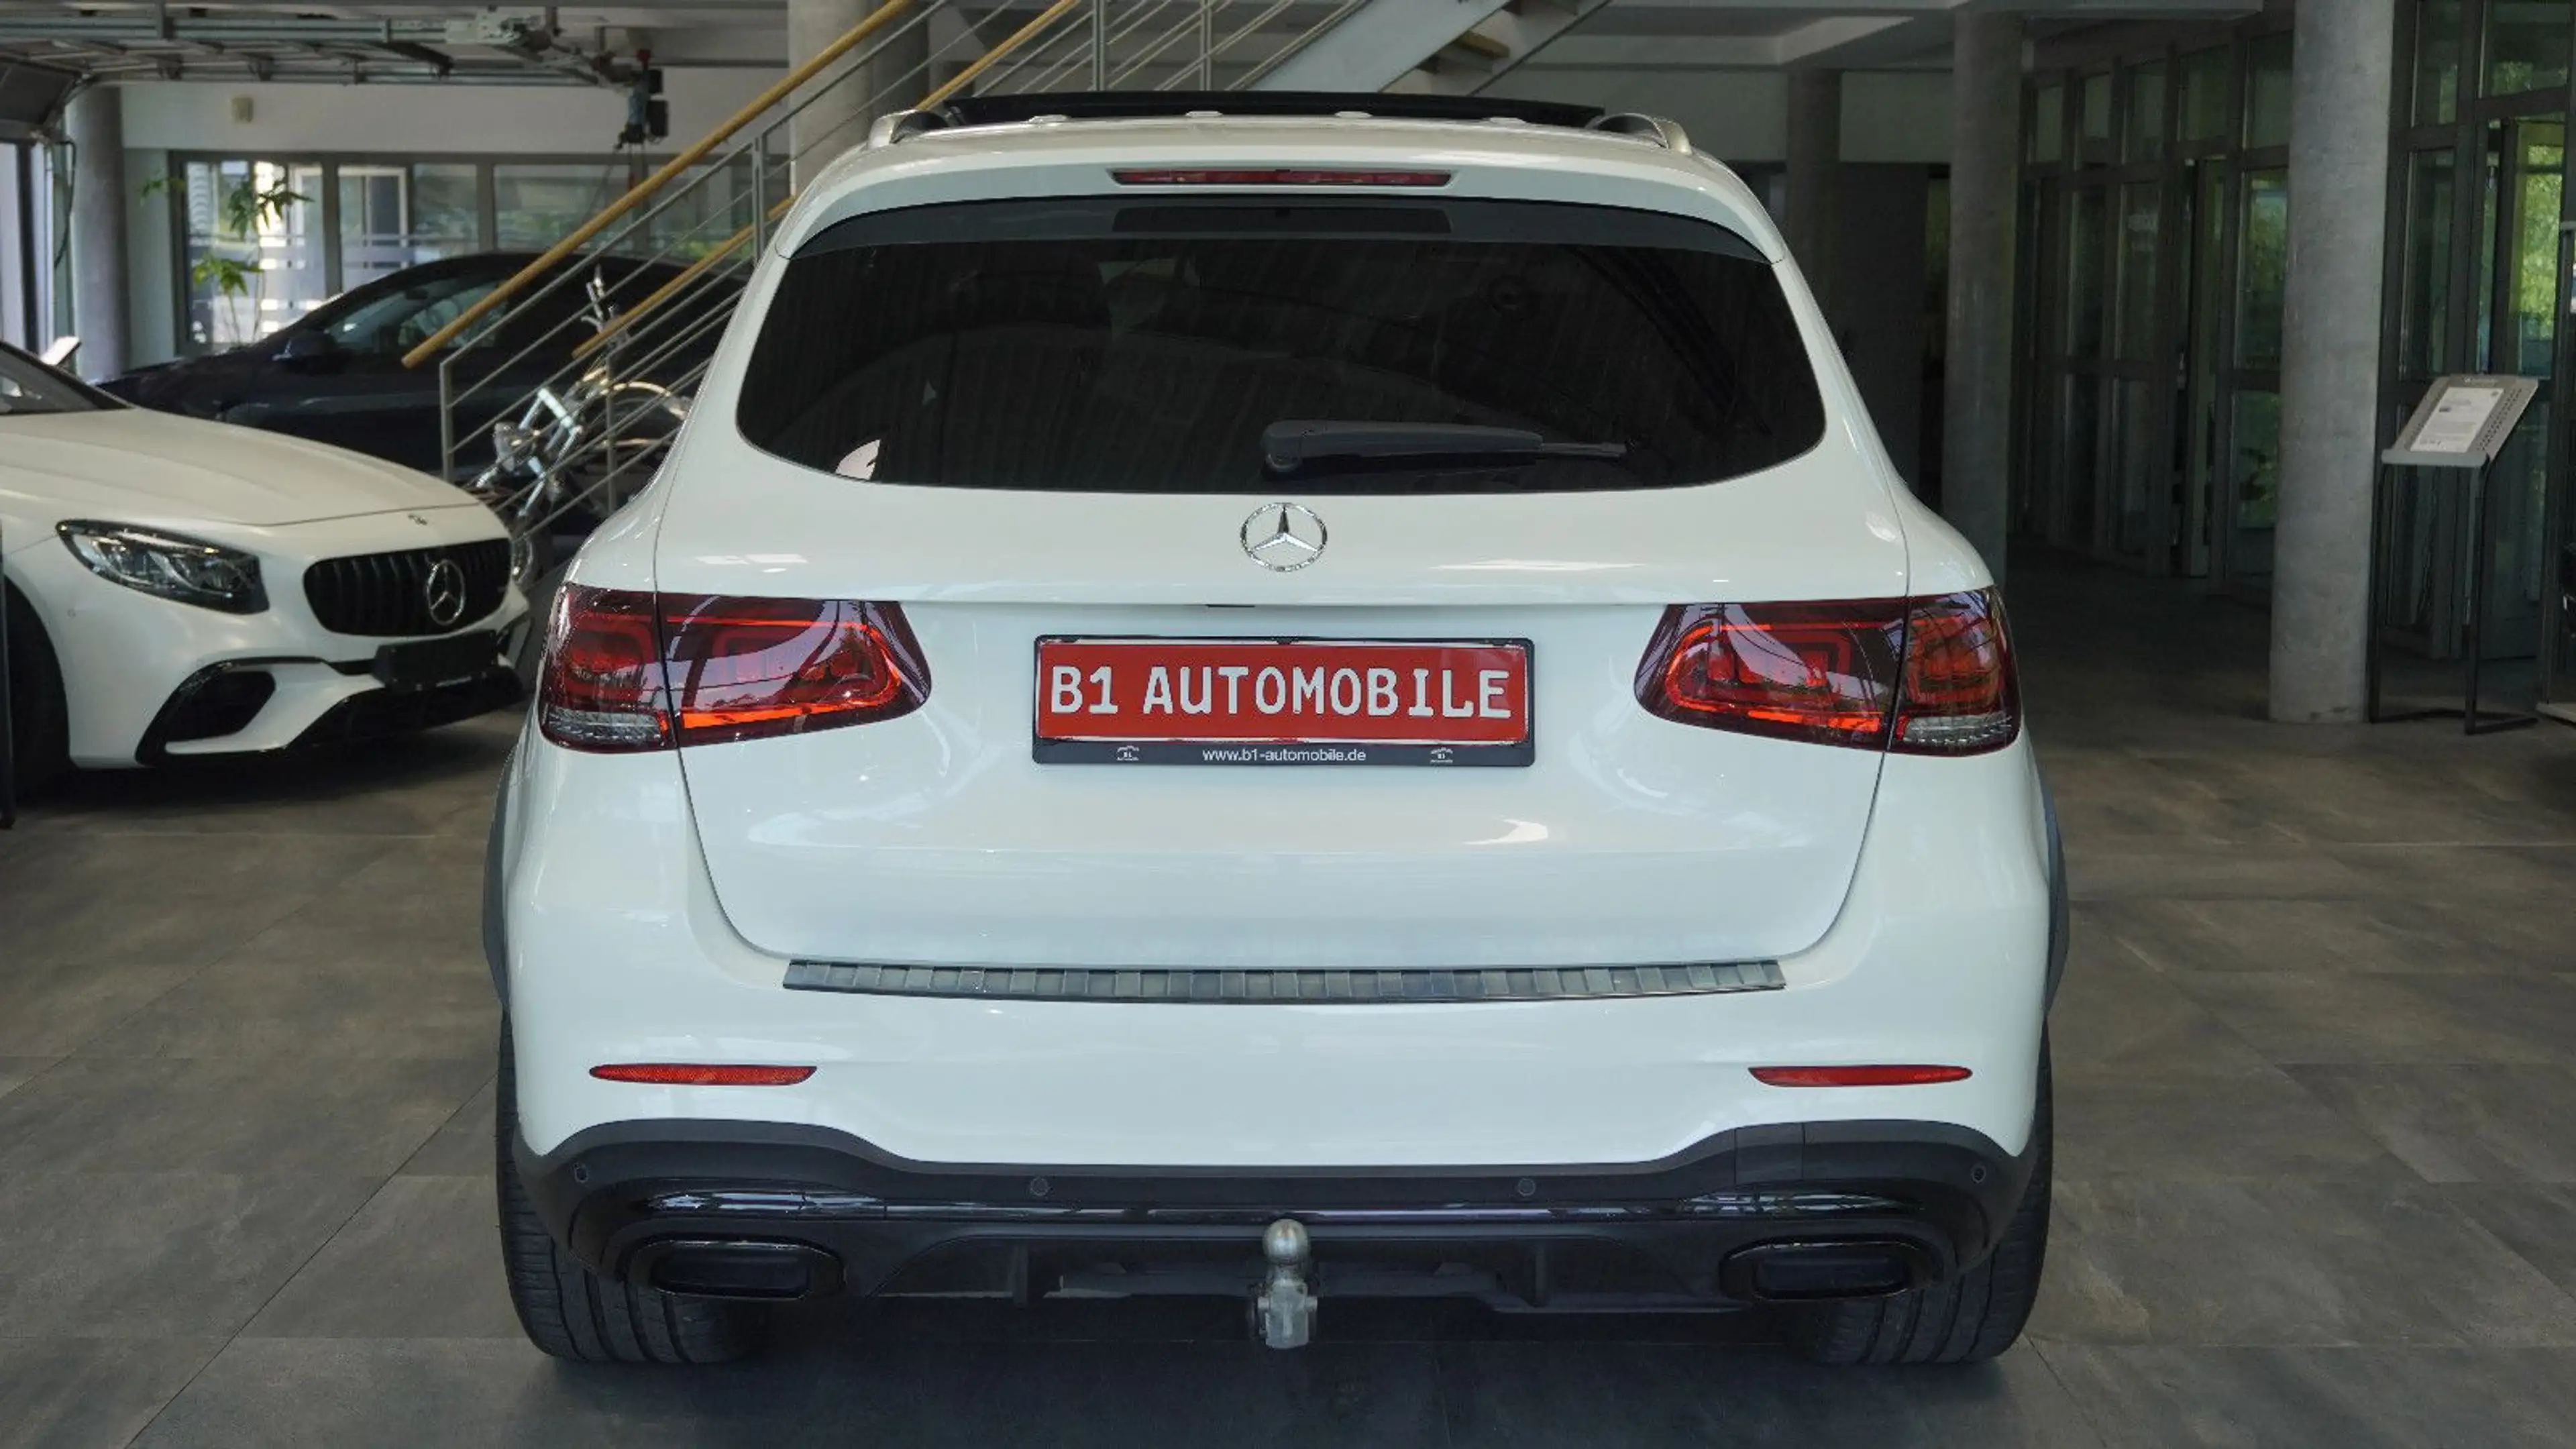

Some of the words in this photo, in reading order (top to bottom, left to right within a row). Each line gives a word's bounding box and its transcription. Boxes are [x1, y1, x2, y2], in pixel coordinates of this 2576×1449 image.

[1051, 665, 1118, 714] B1
[1142, 666, 1511, 718] AUTOMOBILE
[1202, 748, 1366, 761] www.b1-automobile.de
